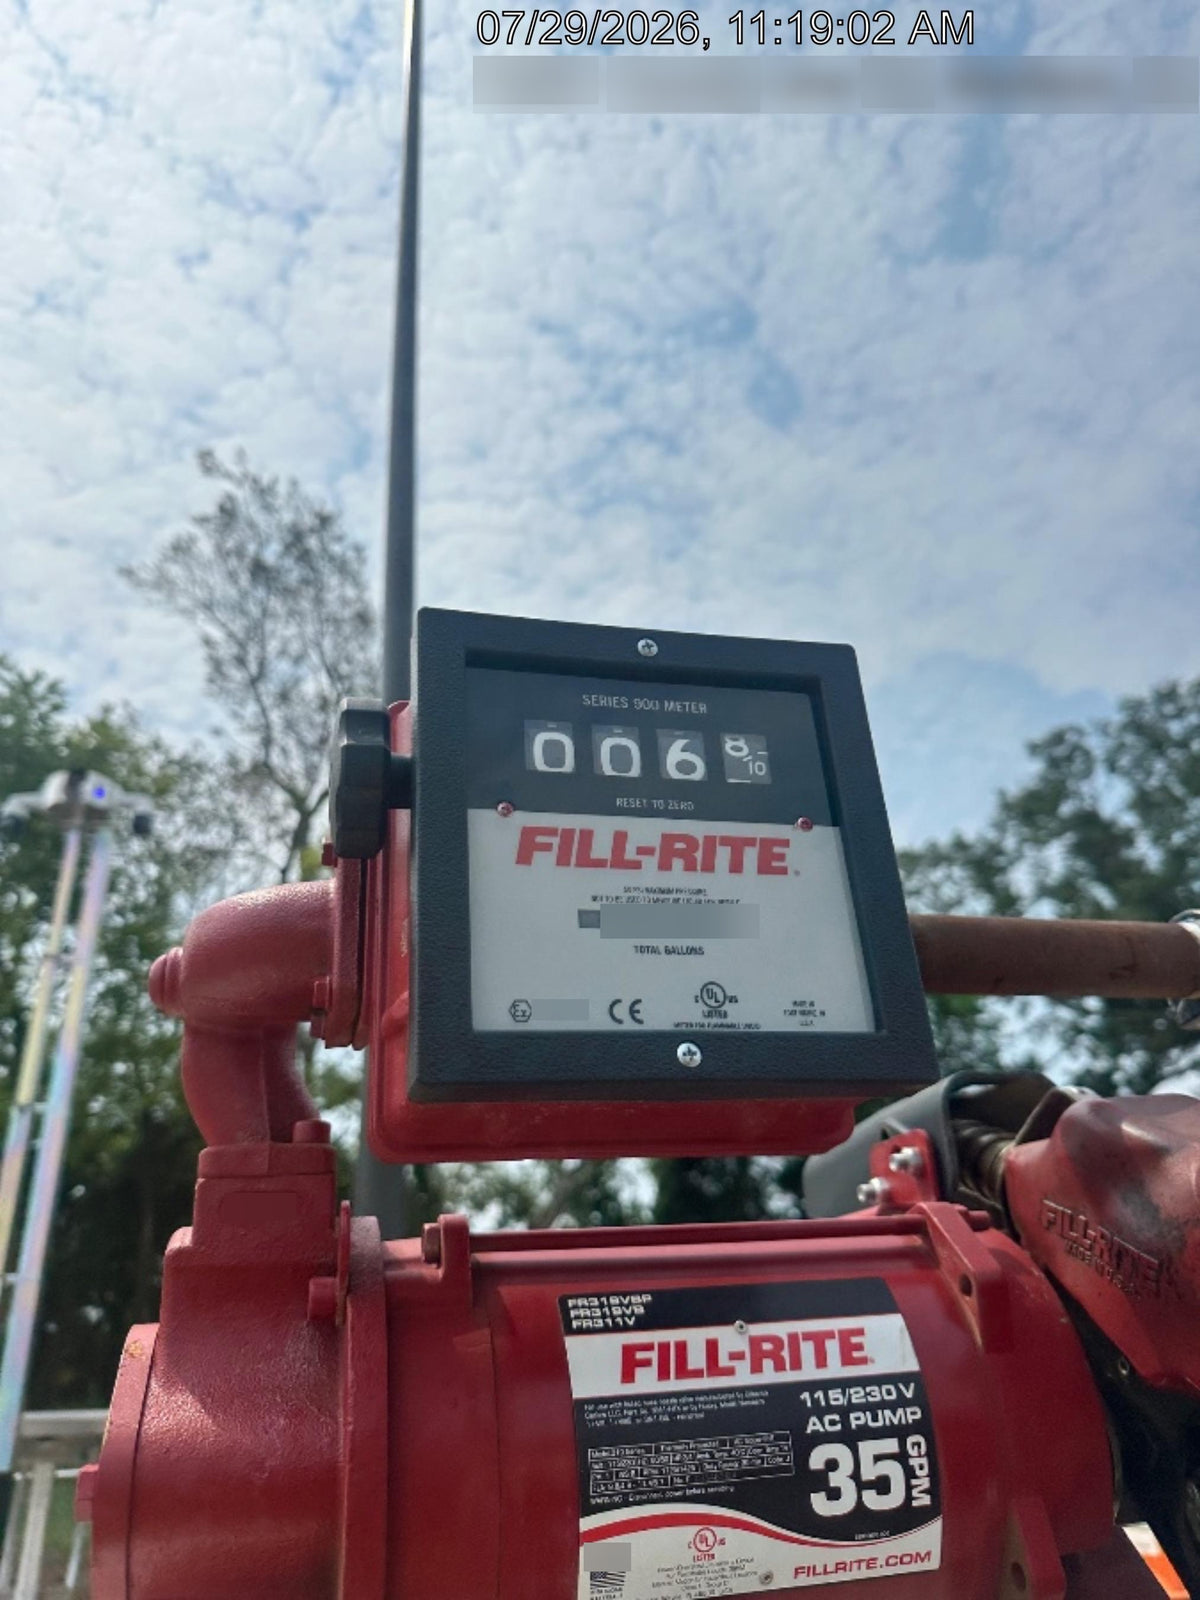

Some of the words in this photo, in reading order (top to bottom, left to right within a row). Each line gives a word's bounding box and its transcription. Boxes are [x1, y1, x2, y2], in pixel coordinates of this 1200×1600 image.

[582, 694, 629, 709] SERIES
[664, 700, 707, 714] METER
[616, 797, 647, 808] RESET
[652, 799, 665, 810] TO
[668, 800, 695, 811] ZERO
[514, 825, 791, 876] FILL-RITE
[633, 945, 662, 955] TOTAL
[664, 945, 705, 956] GALLONS
[572, 1315, 636, 1330] FR311V
[620, 1327, 870, 1385] FILL-RITE
[805, 1413, 842, 1434] AC
[849, 1406, 922, 1429] PUMP
[808, 1437, 906, 1517] 35
[906, 1434, 931, 1507] GPM
[793, 1550, 932, 1579] FILLRITE.COM
